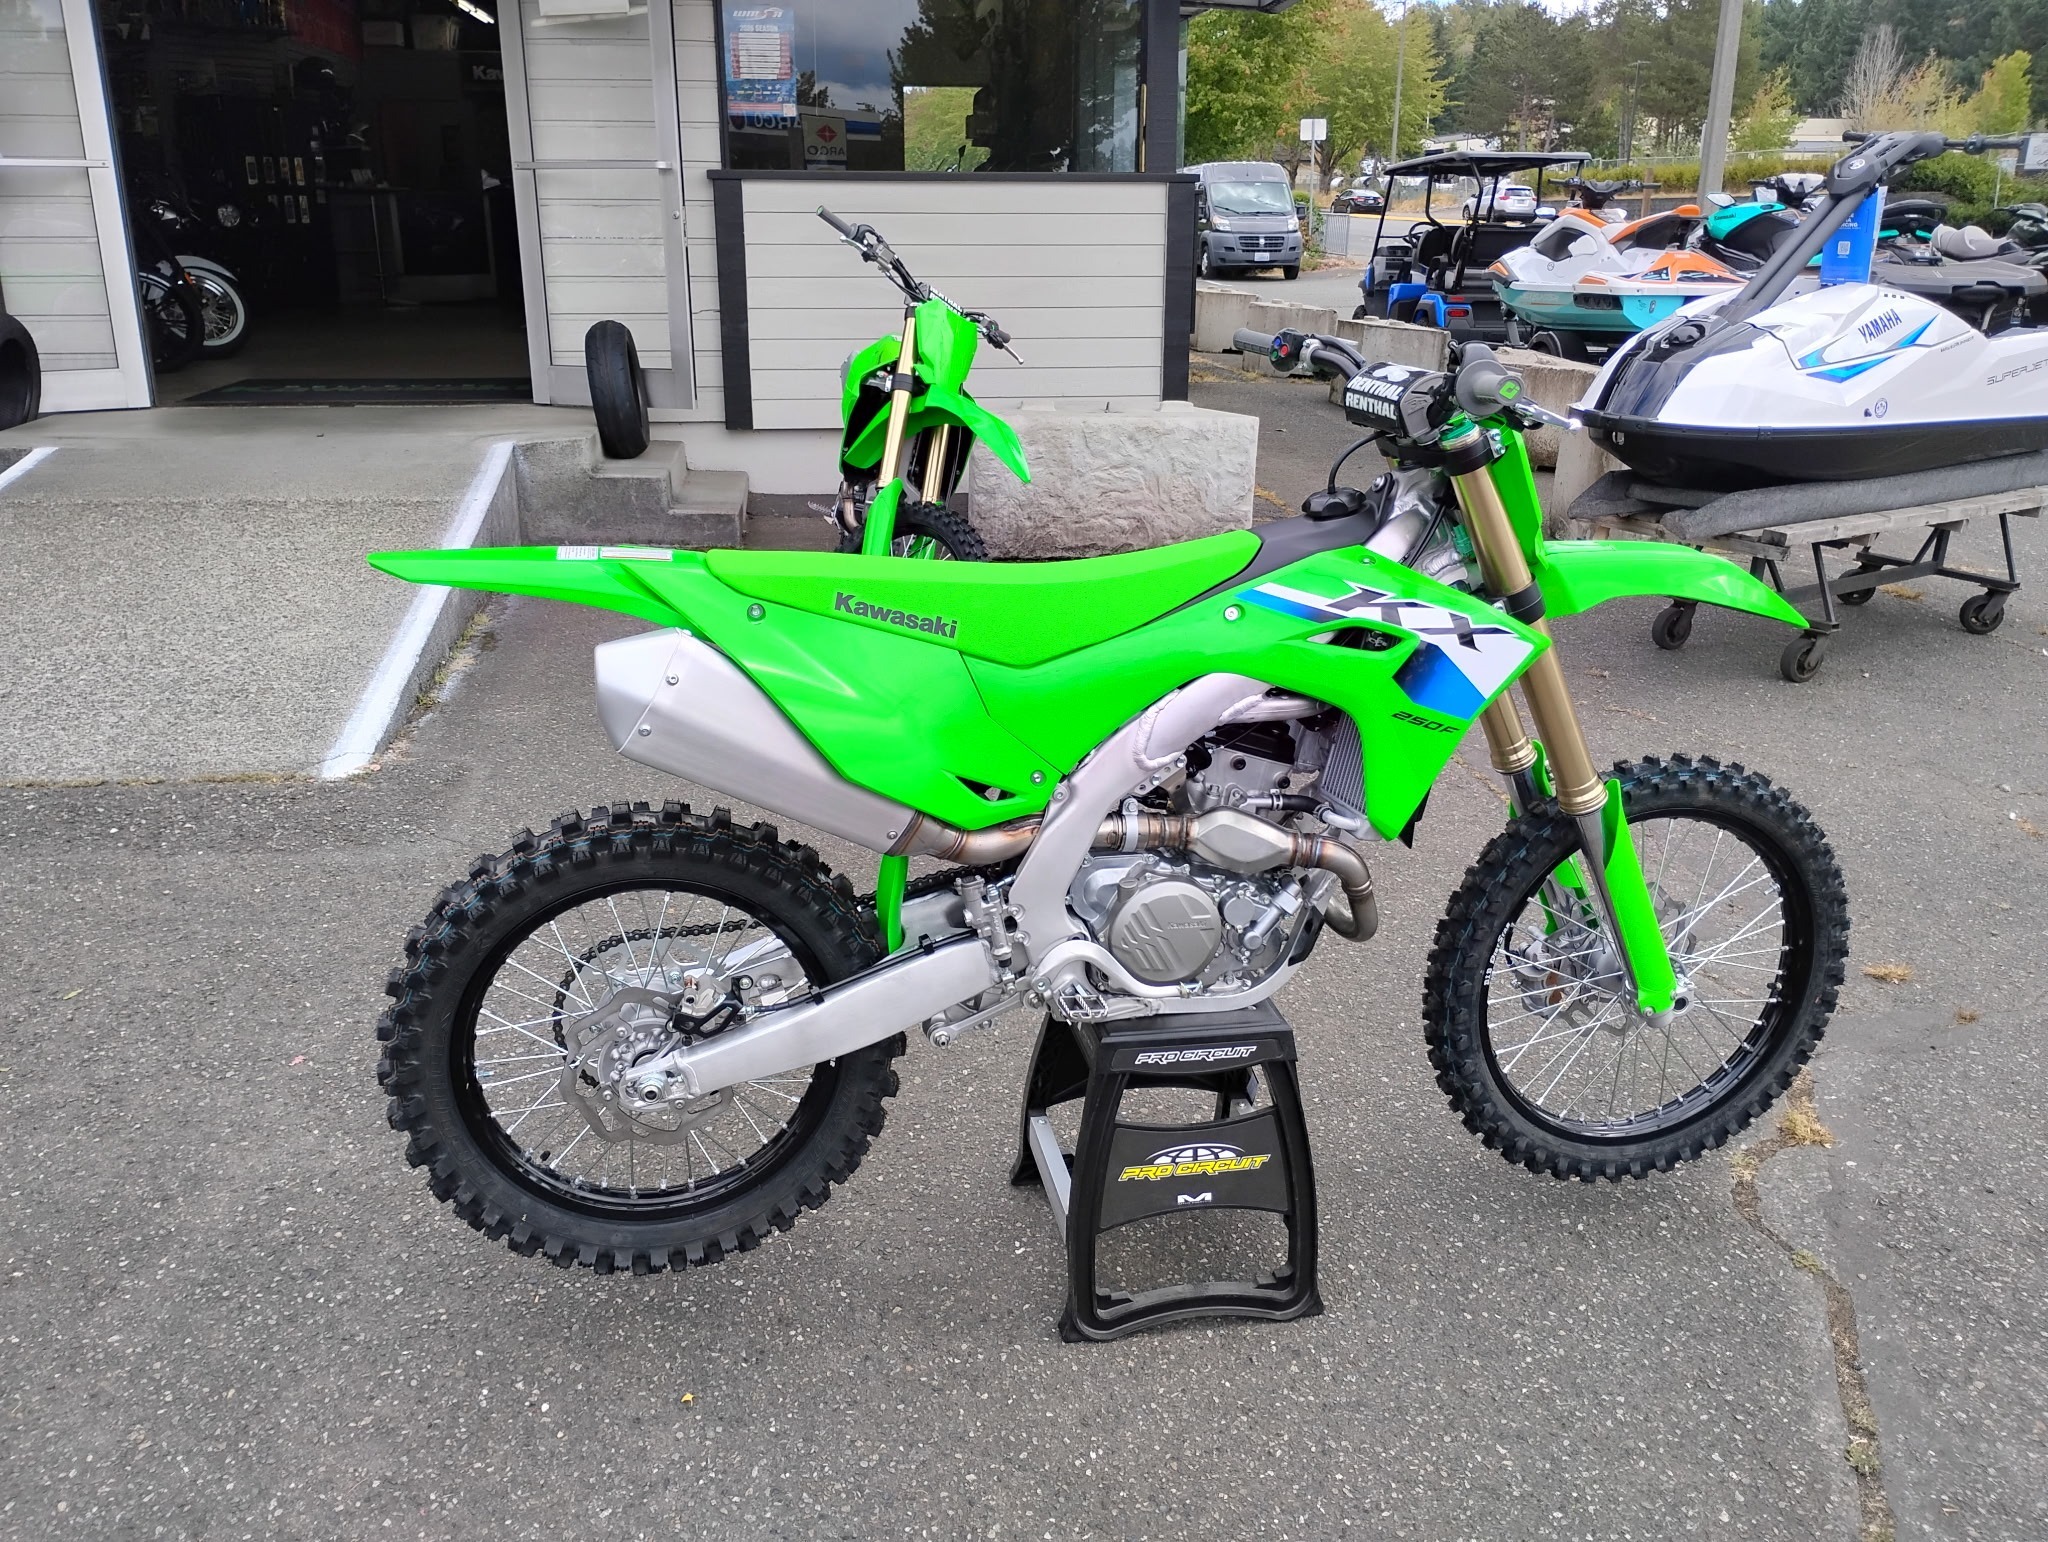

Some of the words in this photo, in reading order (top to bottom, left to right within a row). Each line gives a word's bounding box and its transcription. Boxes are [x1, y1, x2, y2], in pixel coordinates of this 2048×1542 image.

[1857, 308, 1902, 344] YAMAHA
[1347, 375, 1405, 402] RENTHAL
[1345, 391, 1397, 421] RENTHAL
[834, 591, 958, 639] Kawasaki
[1325, 585, 1515, 654] KX
[1391, 710, 1461, 734] 250F
[1134, 1050, 1180, 1064] PRO
[1179, 1045, 1257, 1062] CIRCUIT
[1118, 1163, 1174, 1182] PRO
[1175, 1154, 1271, 1176] CIRCUIT
